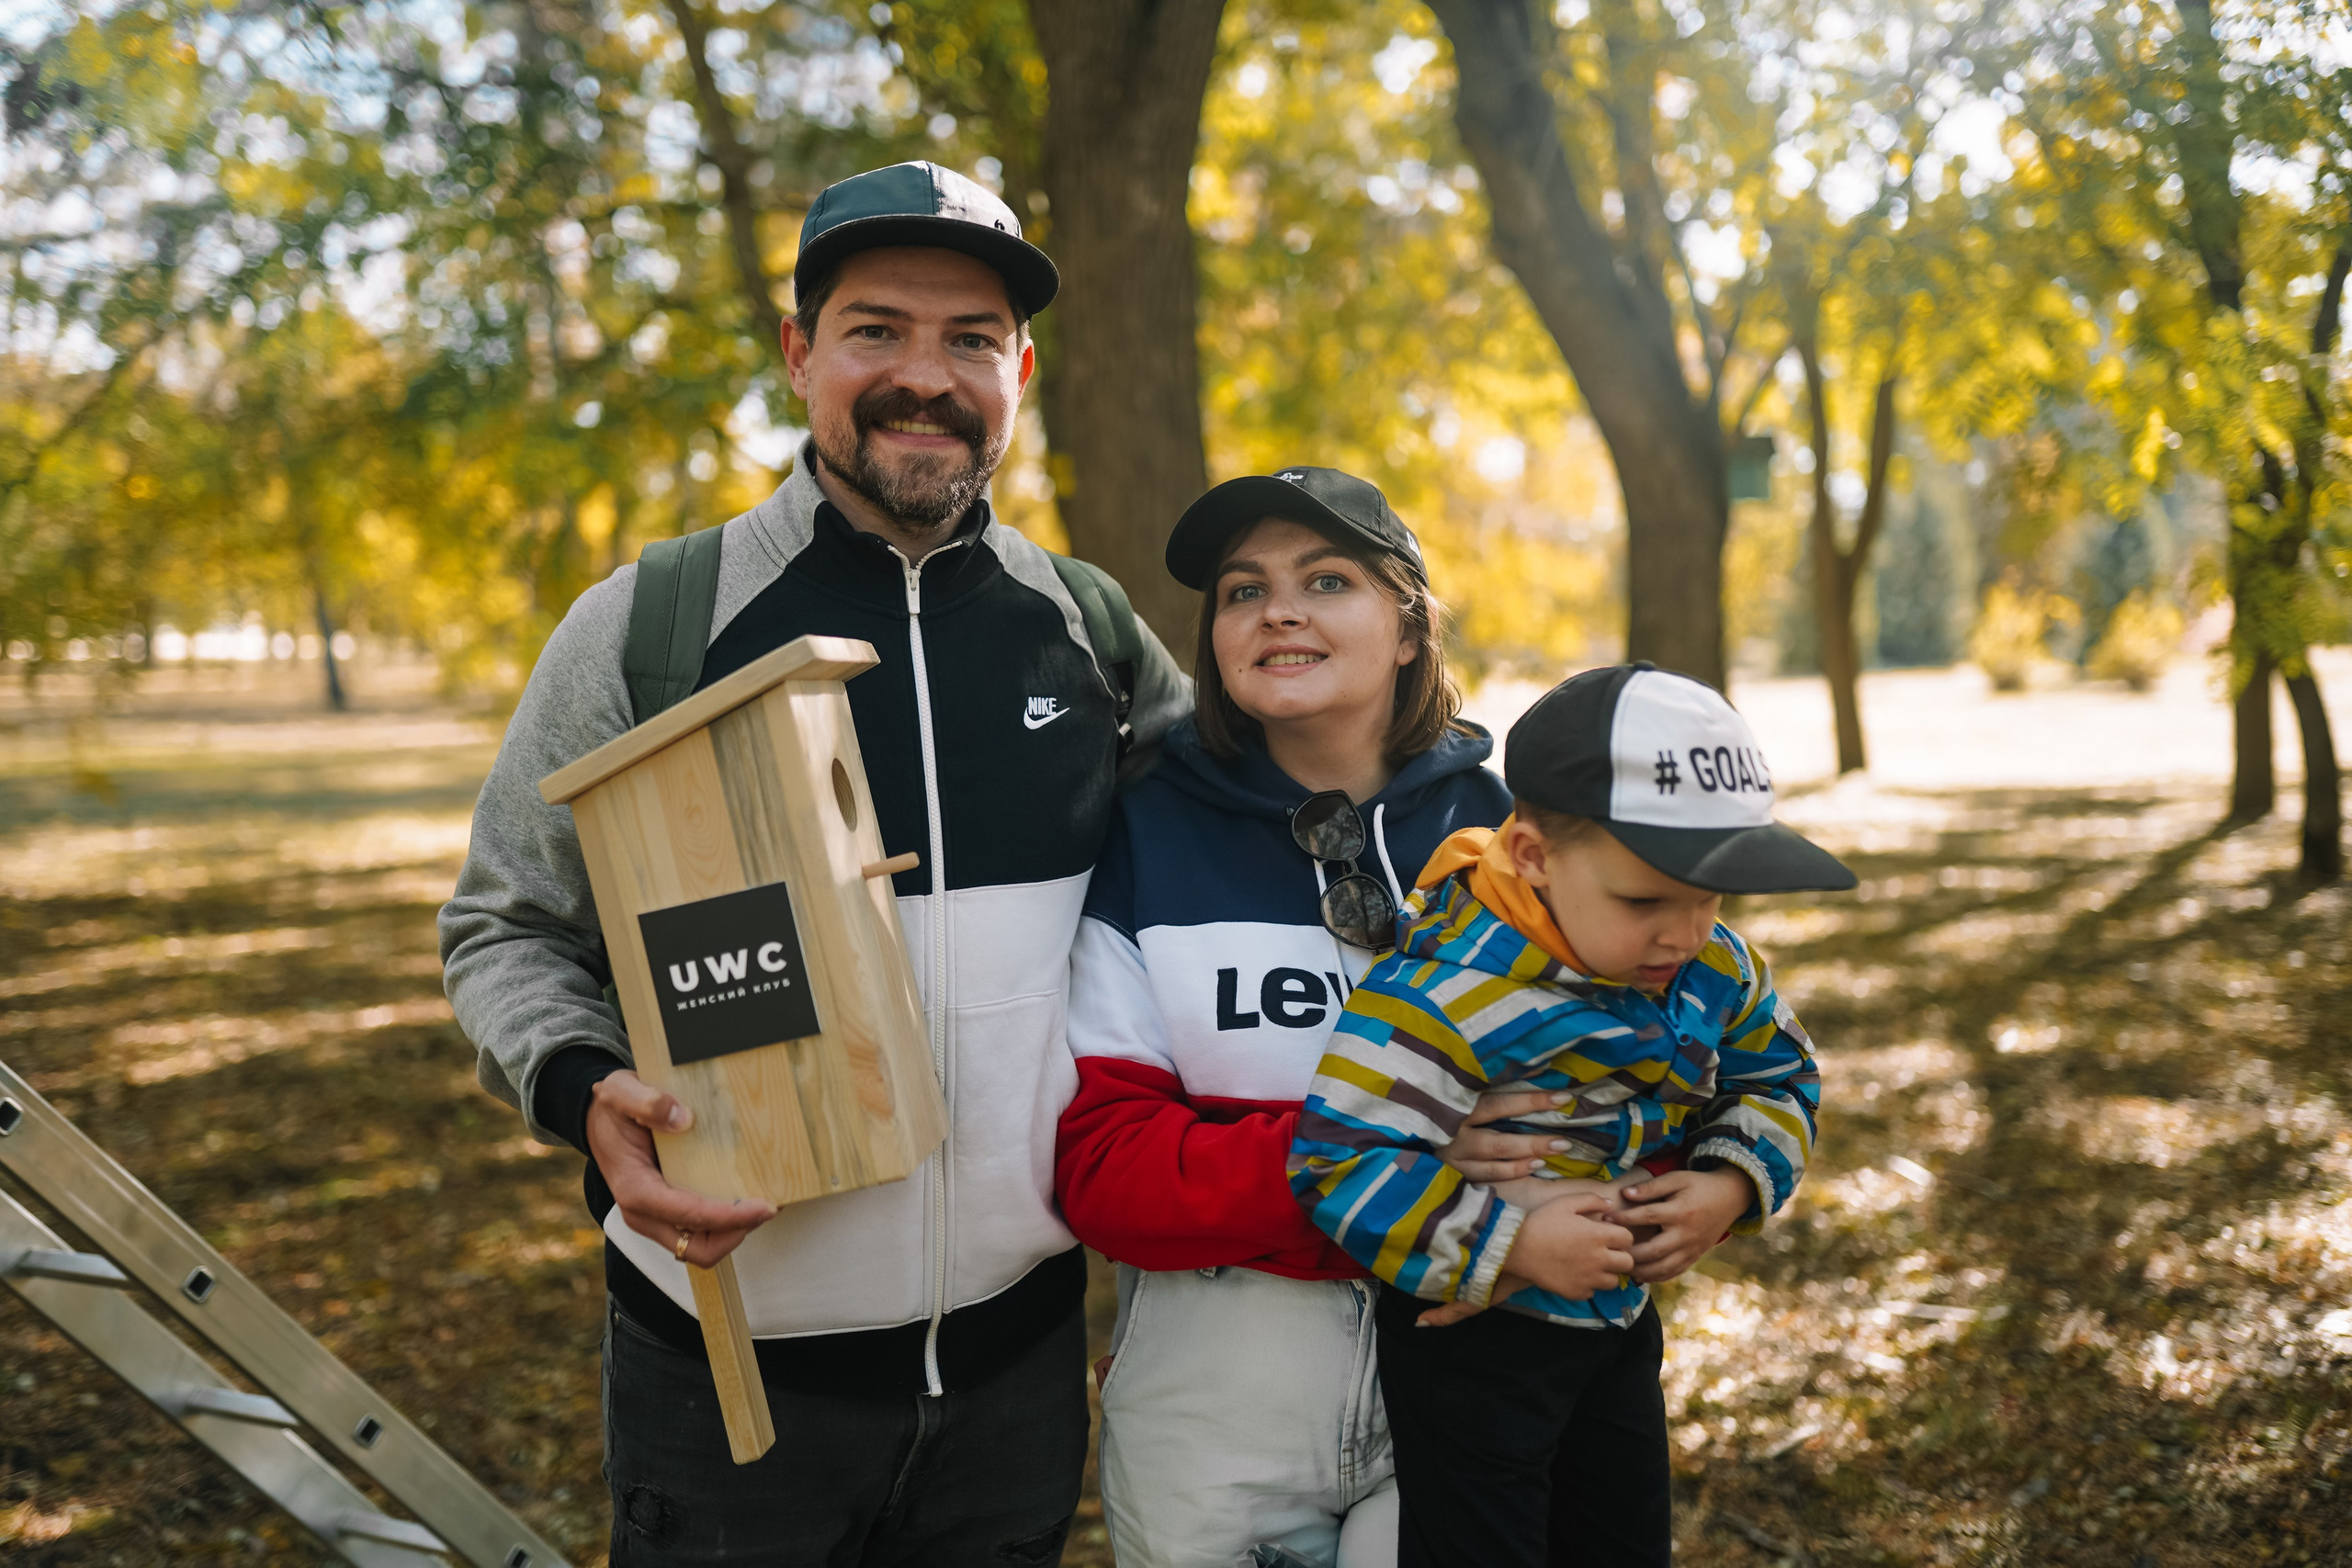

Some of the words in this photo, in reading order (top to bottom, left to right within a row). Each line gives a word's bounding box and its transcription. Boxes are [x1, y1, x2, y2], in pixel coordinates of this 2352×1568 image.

[1027, 696, 1057, 716] NIKE
[669, 941, 787, 992] UWC
[676, 986, 747, 1011] ЖЕНСКИЙ
[752, 978, 791, 994] КЛУБ
